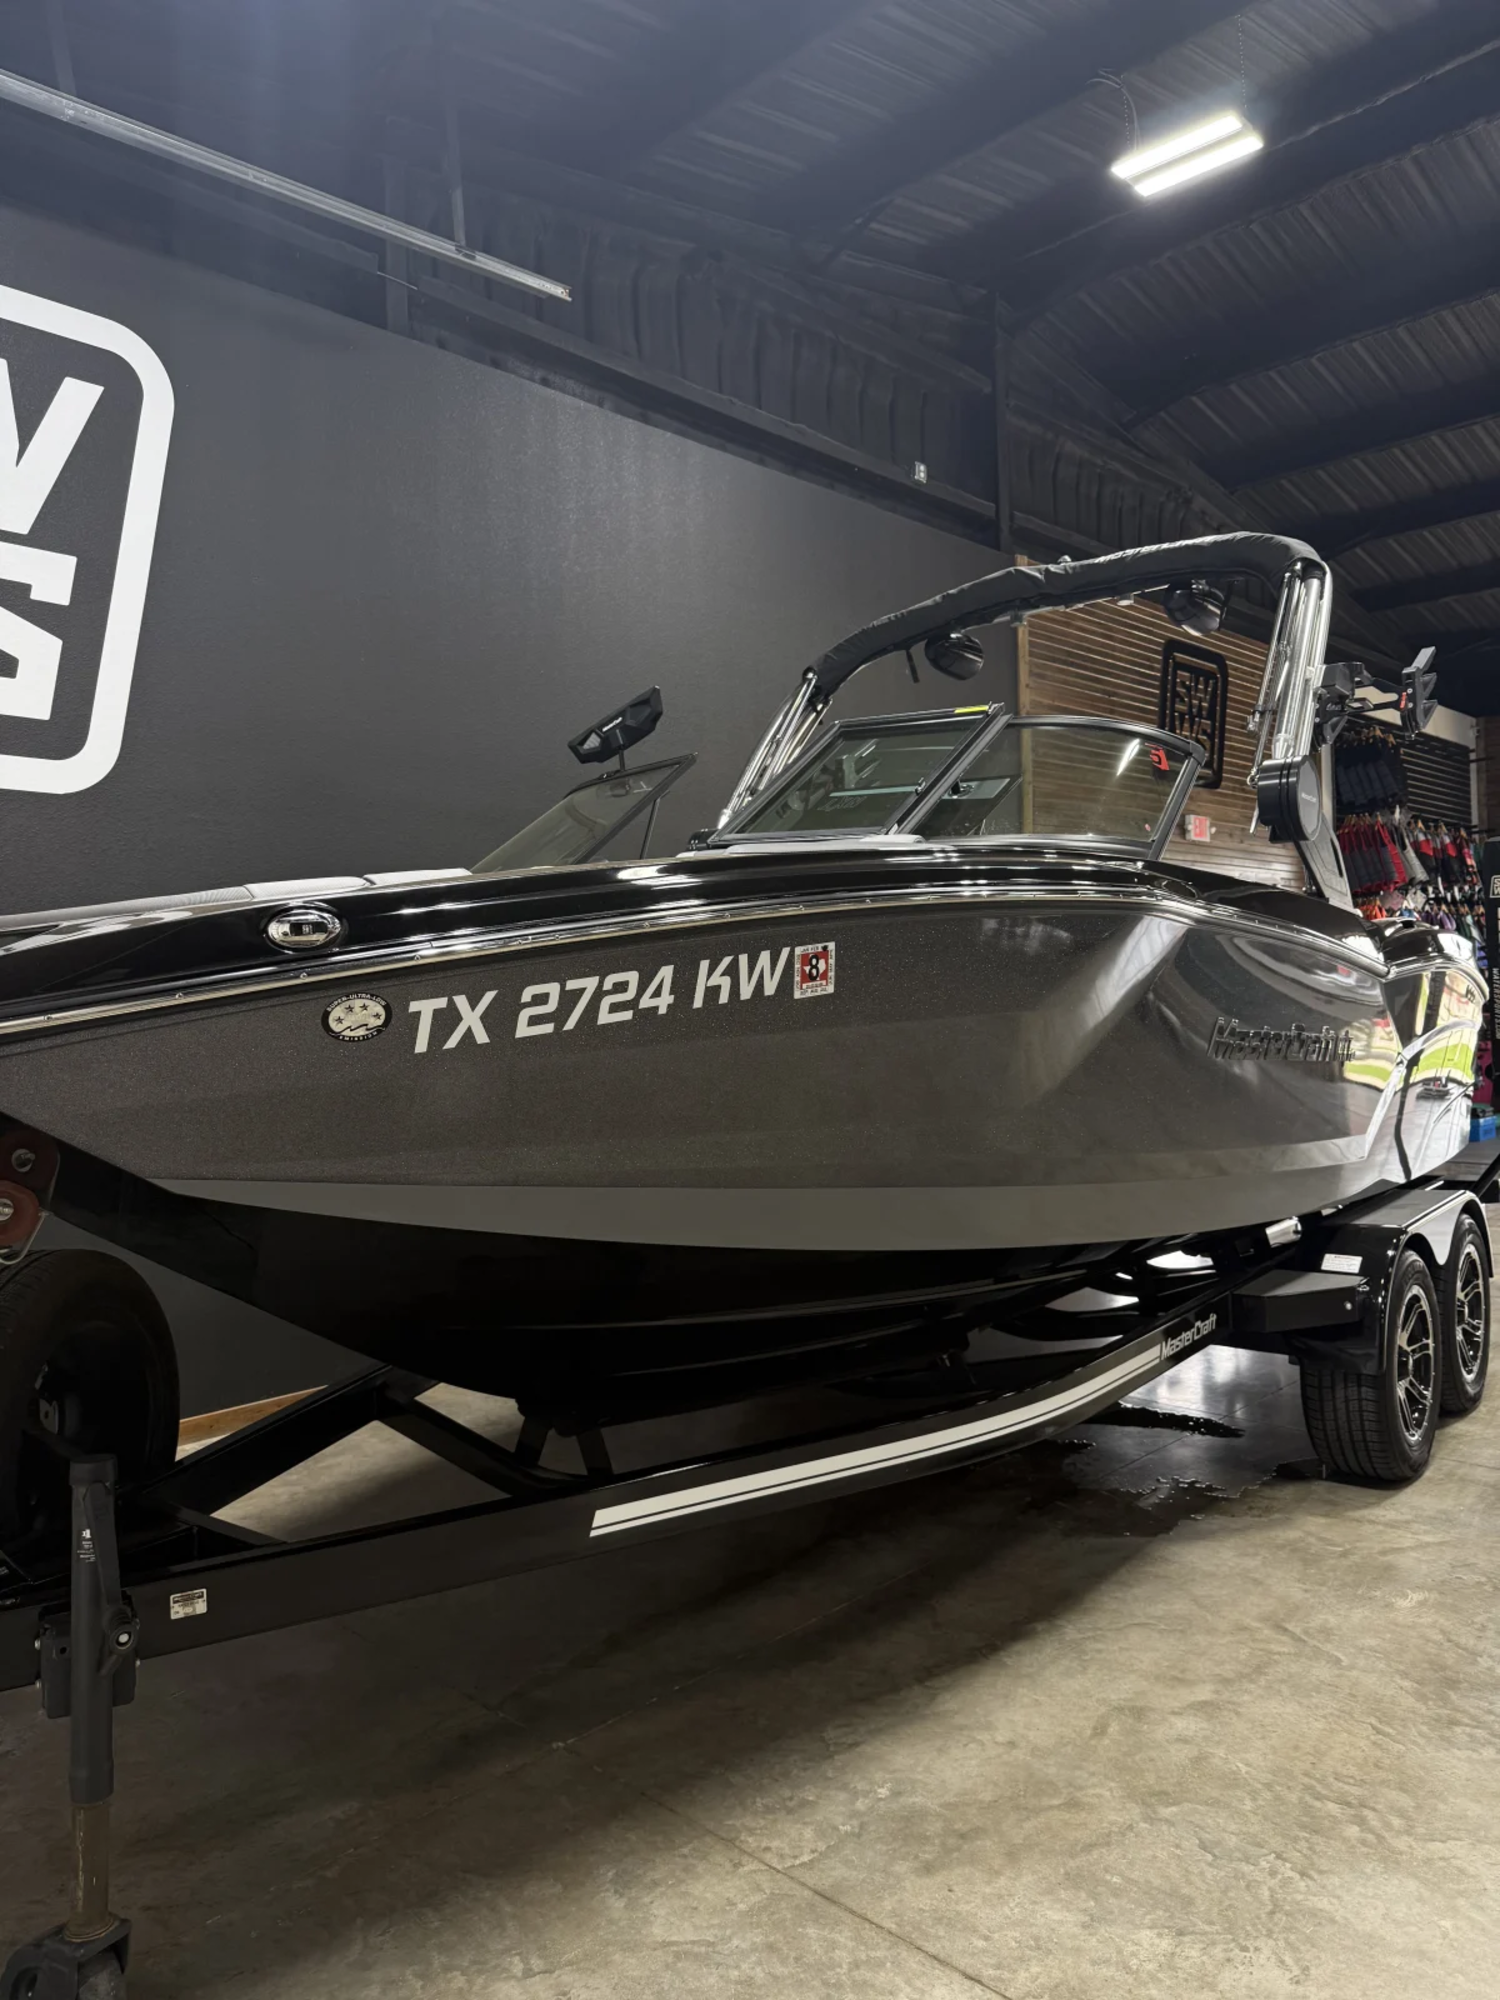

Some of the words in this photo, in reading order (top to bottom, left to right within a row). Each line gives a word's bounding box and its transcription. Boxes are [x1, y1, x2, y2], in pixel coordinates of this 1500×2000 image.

[808, 954, 820, 981] 8
[408, 990, 499, 1054] TX
[515, 965, 675, 1039] 2724
[692, 947, 791, 1009] KW
[1161, 1312, 1217, 1361] MasterCraft
